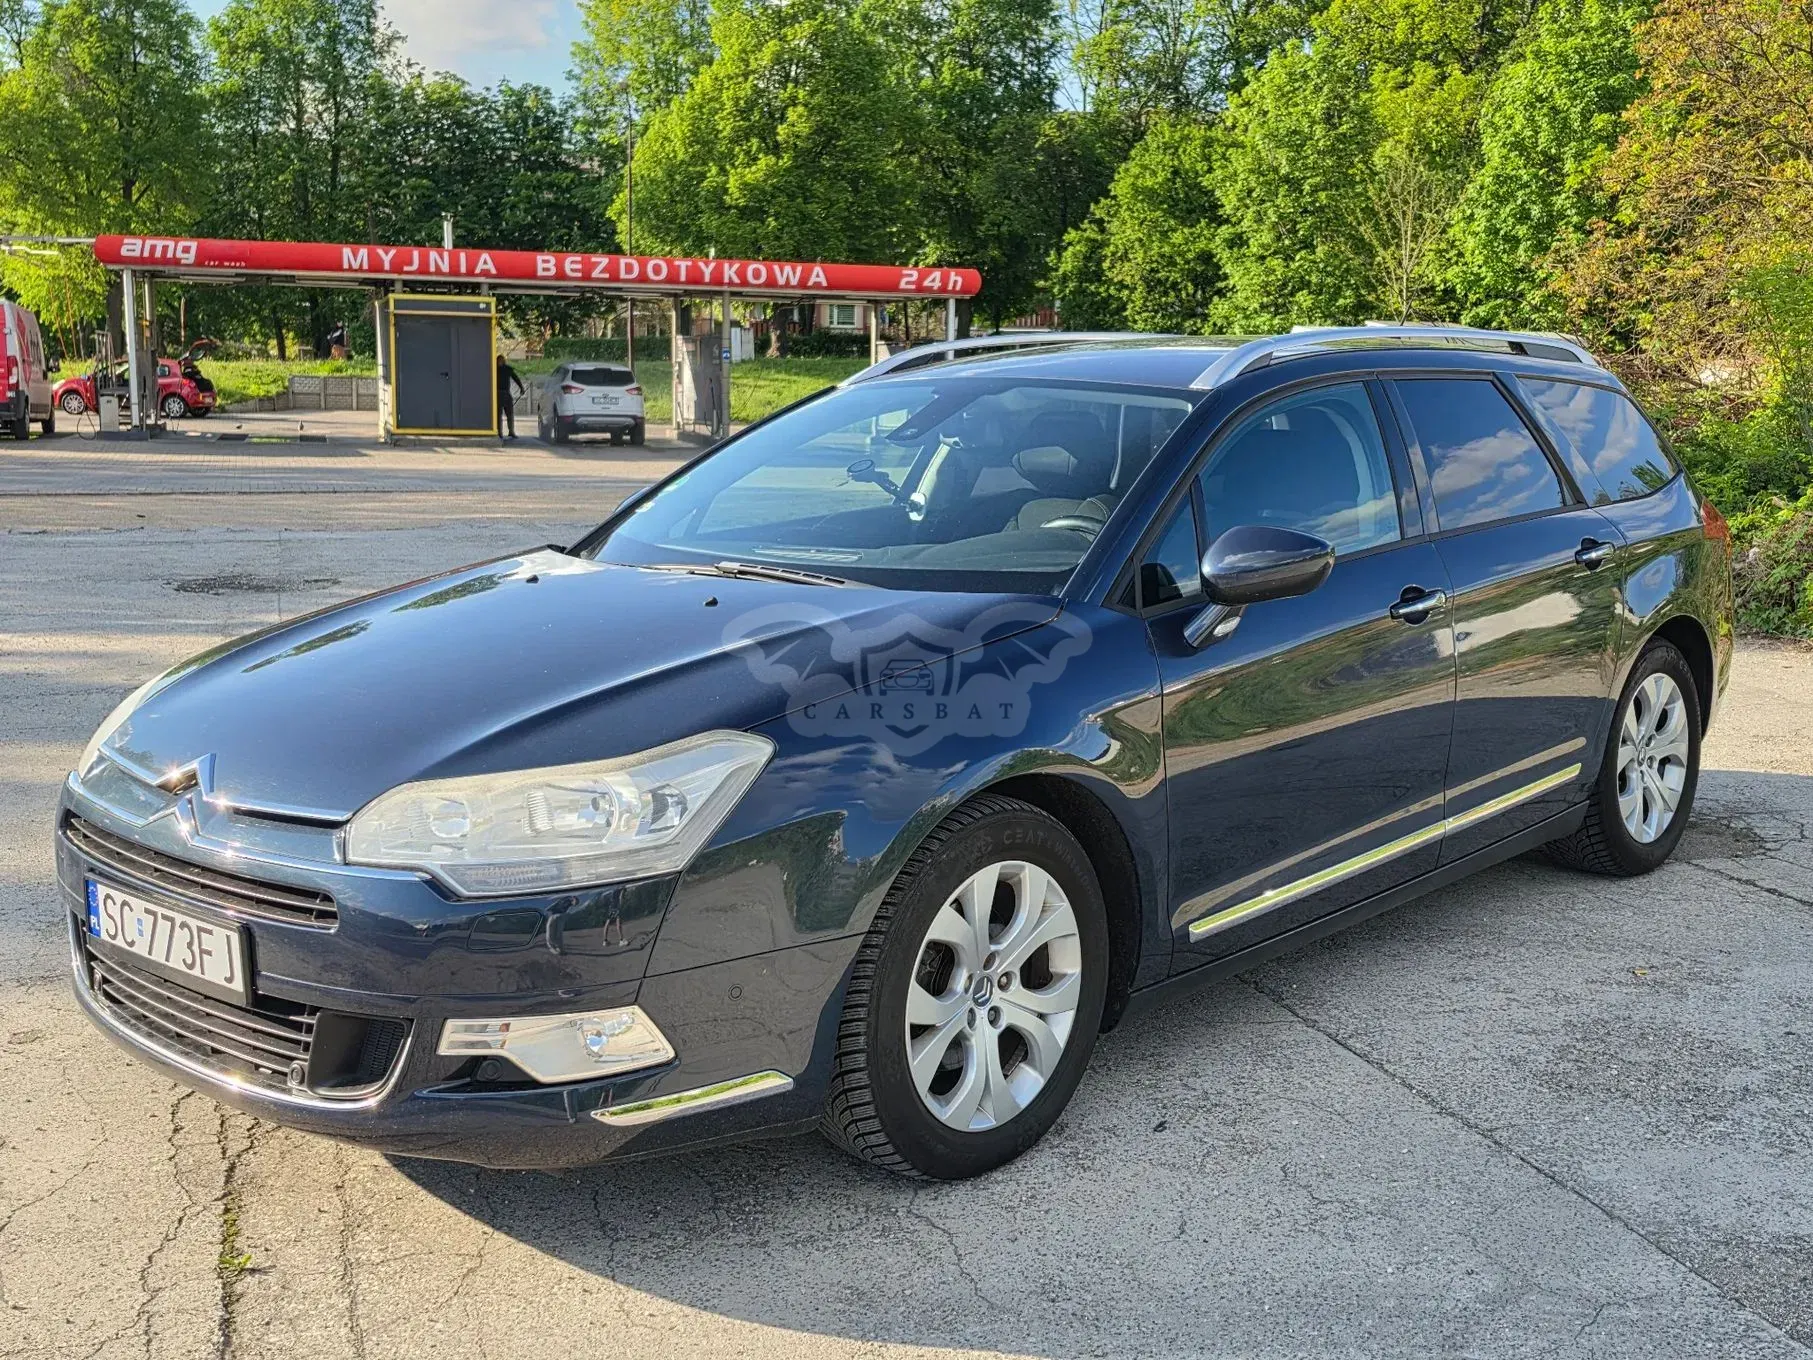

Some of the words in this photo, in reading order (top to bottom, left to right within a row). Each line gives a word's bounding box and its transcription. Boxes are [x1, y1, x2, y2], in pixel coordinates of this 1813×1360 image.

[120, 238, 198, 264] amg
[343, 247, 496, 275] MYJNIA
[536, 255, 828, 288] BEZDOTYKOWA
[899, 270, 963, 292] 24h
[90, 915, 100, 931] PL
[103, 892, 136, 949] SC
[143, 907, 236, 984] 773FJ
